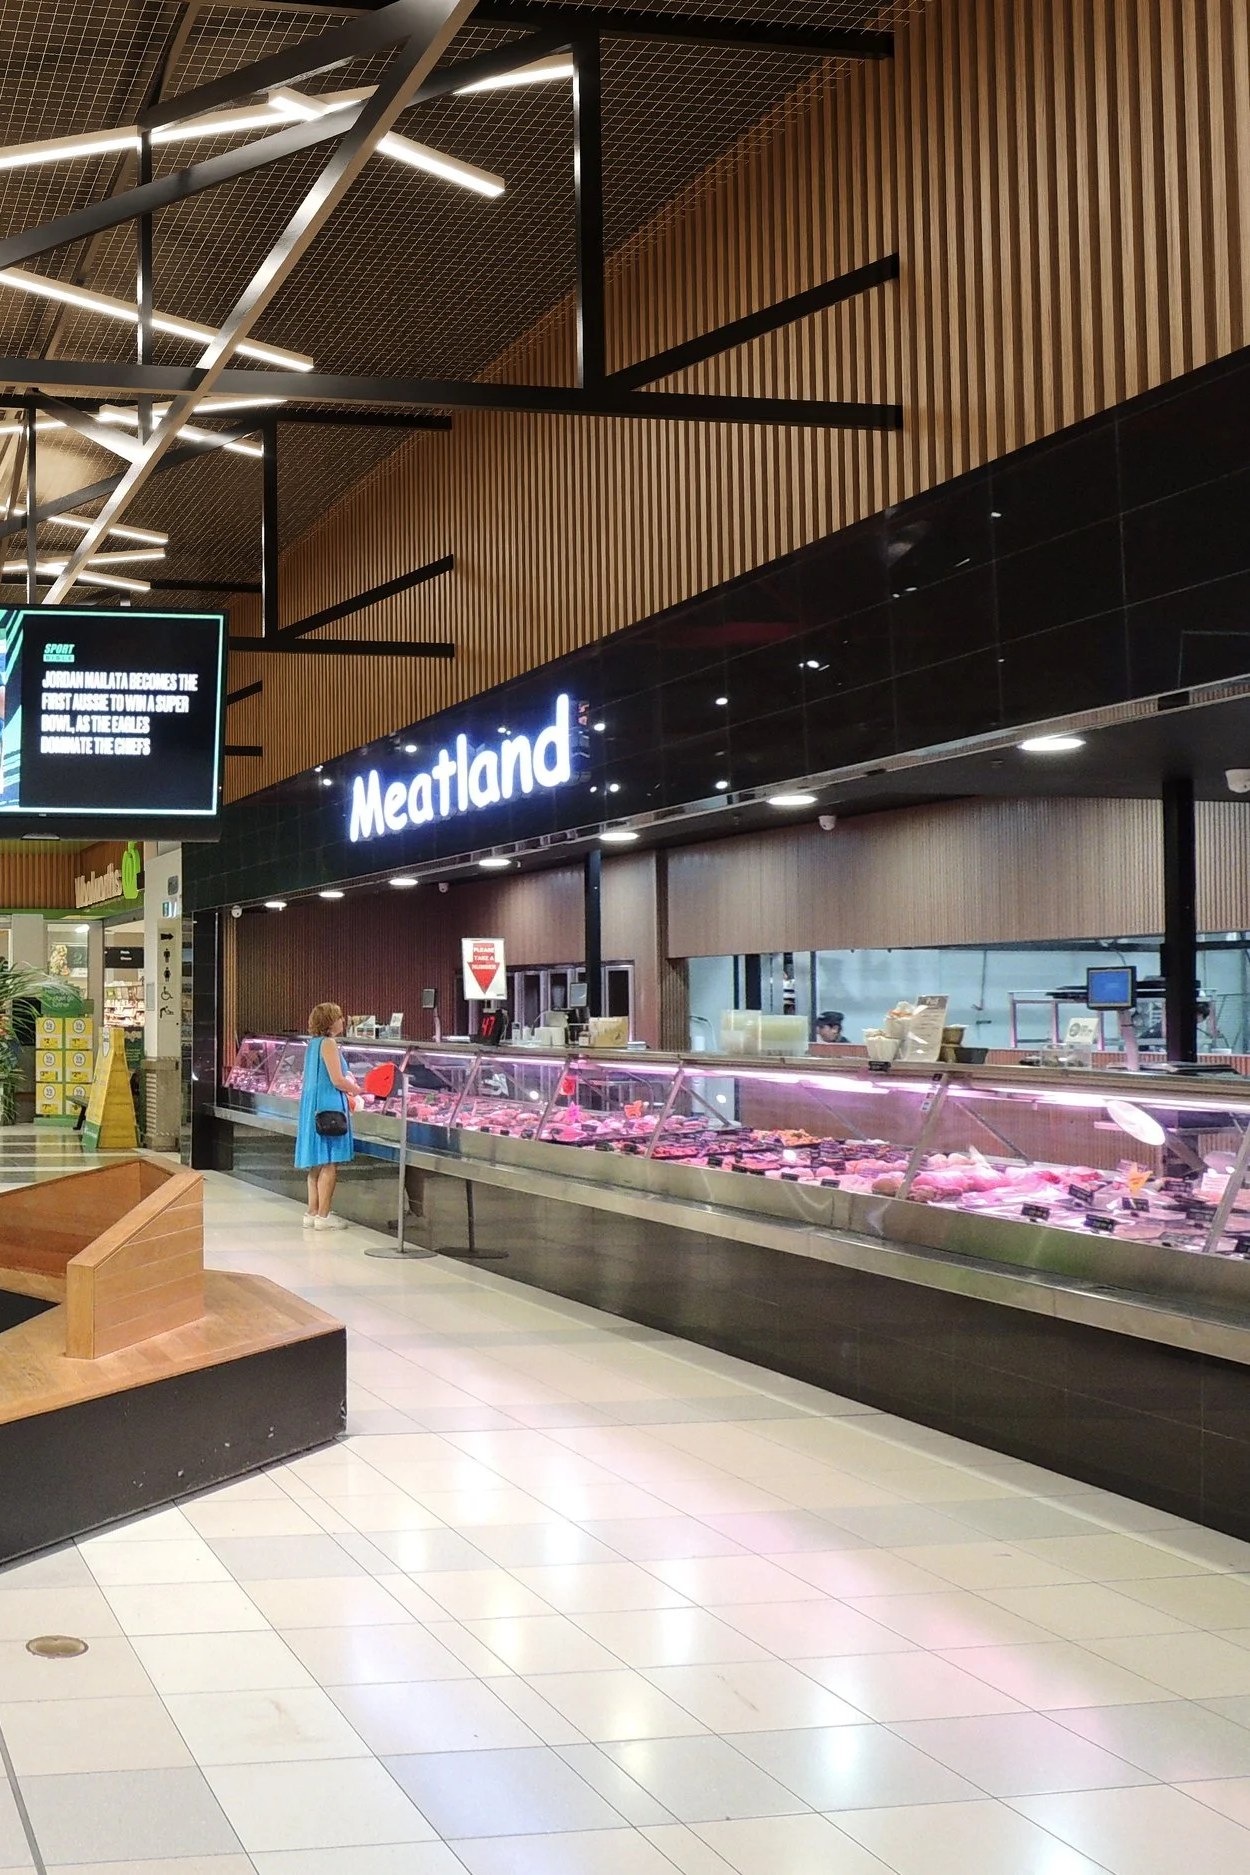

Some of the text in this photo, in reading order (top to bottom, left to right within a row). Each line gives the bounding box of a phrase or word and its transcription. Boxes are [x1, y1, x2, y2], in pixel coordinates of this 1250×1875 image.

[44, 643, 75, 654] SPORT
[42, 670, 84, 689] JORDAN
[129, 672, 177, 691] BECOMES
[178, 673, 199, 692] THE
[41, 692, 189, 713] FIRST AUSSIE TO WIN A SUPER
[76, 715, 91, 732] AS
[91, 715, 111, 733] THE
[112, 716, 150, 734] EAGLES
[41, 736, 151, 756] DOMINATE THE CHIEFS
[349, 693, 571, 843] Meatland
[481, 1016, 495, 1037] 47
